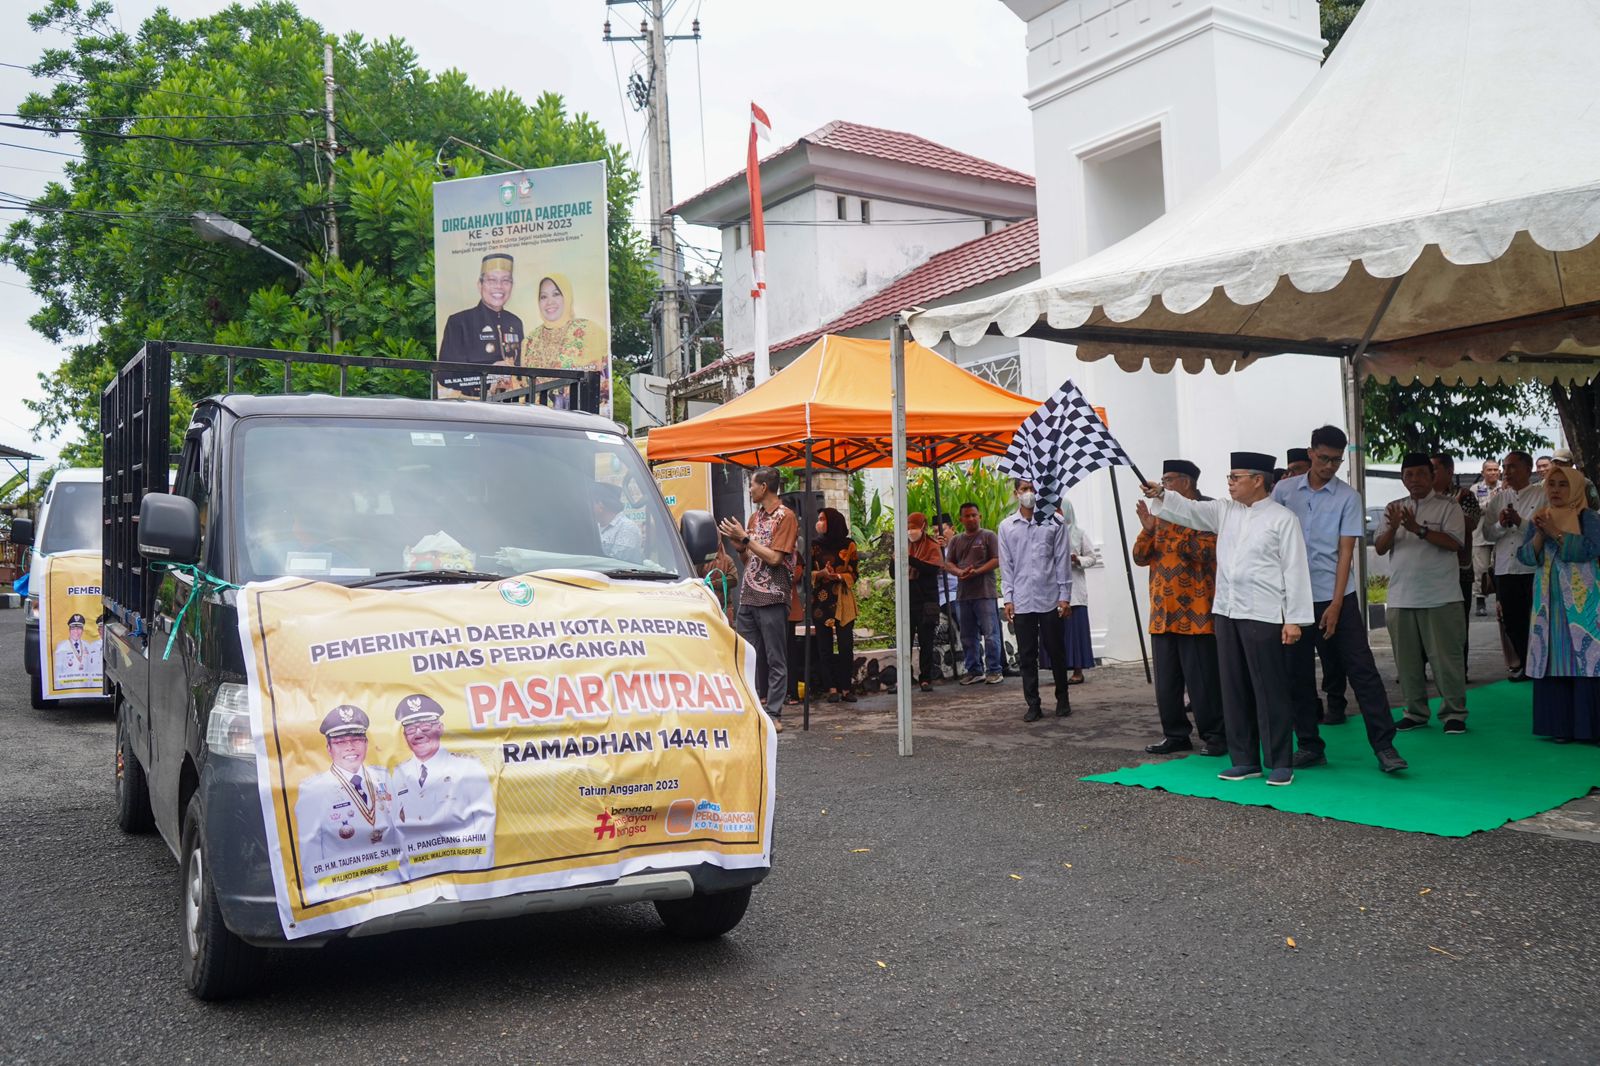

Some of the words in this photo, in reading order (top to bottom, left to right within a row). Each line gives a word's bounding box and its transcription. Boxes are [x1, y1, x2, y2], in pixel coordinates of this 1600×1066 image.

[442, 213, 503, 233] DIRGAHAYU
[505, 209, 532, 225] KOTA
[535, 201, 593, 221] PAREPARE
[468, 229, 482, 240] KE
[491, 227, 504, 237] 63
[506, 222, 544, 235] TAHUN
[547, 218, 572, 230] 2023
[310, 628, 461, 662] PEMERINTAH
[466, 621, 557, 643] DAERAH
[560, 619, 614, 636] KOTA
[617, 618, 709, 637] PAREPARE
[412, 648, 484, 673] DINAS
[490, 640, 646, 664] PERDAGANGAN
[469, 676, 610, 724] PASAR
[614, 672, 743, 710] MURAH
[503, 731, 652, 763] RAMADHAN
[658, 728, 708, 749] 1444
[714, 729, 729, 749] H
[609, 783, 653, 795] Anggaran
[656, 779, 679, 790] 2023
[695, 821, 719, 830] KOTA
[407, 844, 416, 852] H.
[417, 836, 460, 850] PANGERANG
[462, 834, 486, 843] RAHIM
[431, 848, 456, 858] WALIKOTA
[314, 864, 324, 874] DR.
[325, 861, 338, 871] H.M.
[338, 855, 361, 867] TAUFAN
[331, 871, 359, 883] WALIKOTA
[360, 865, 389, 877] PAREPARE
